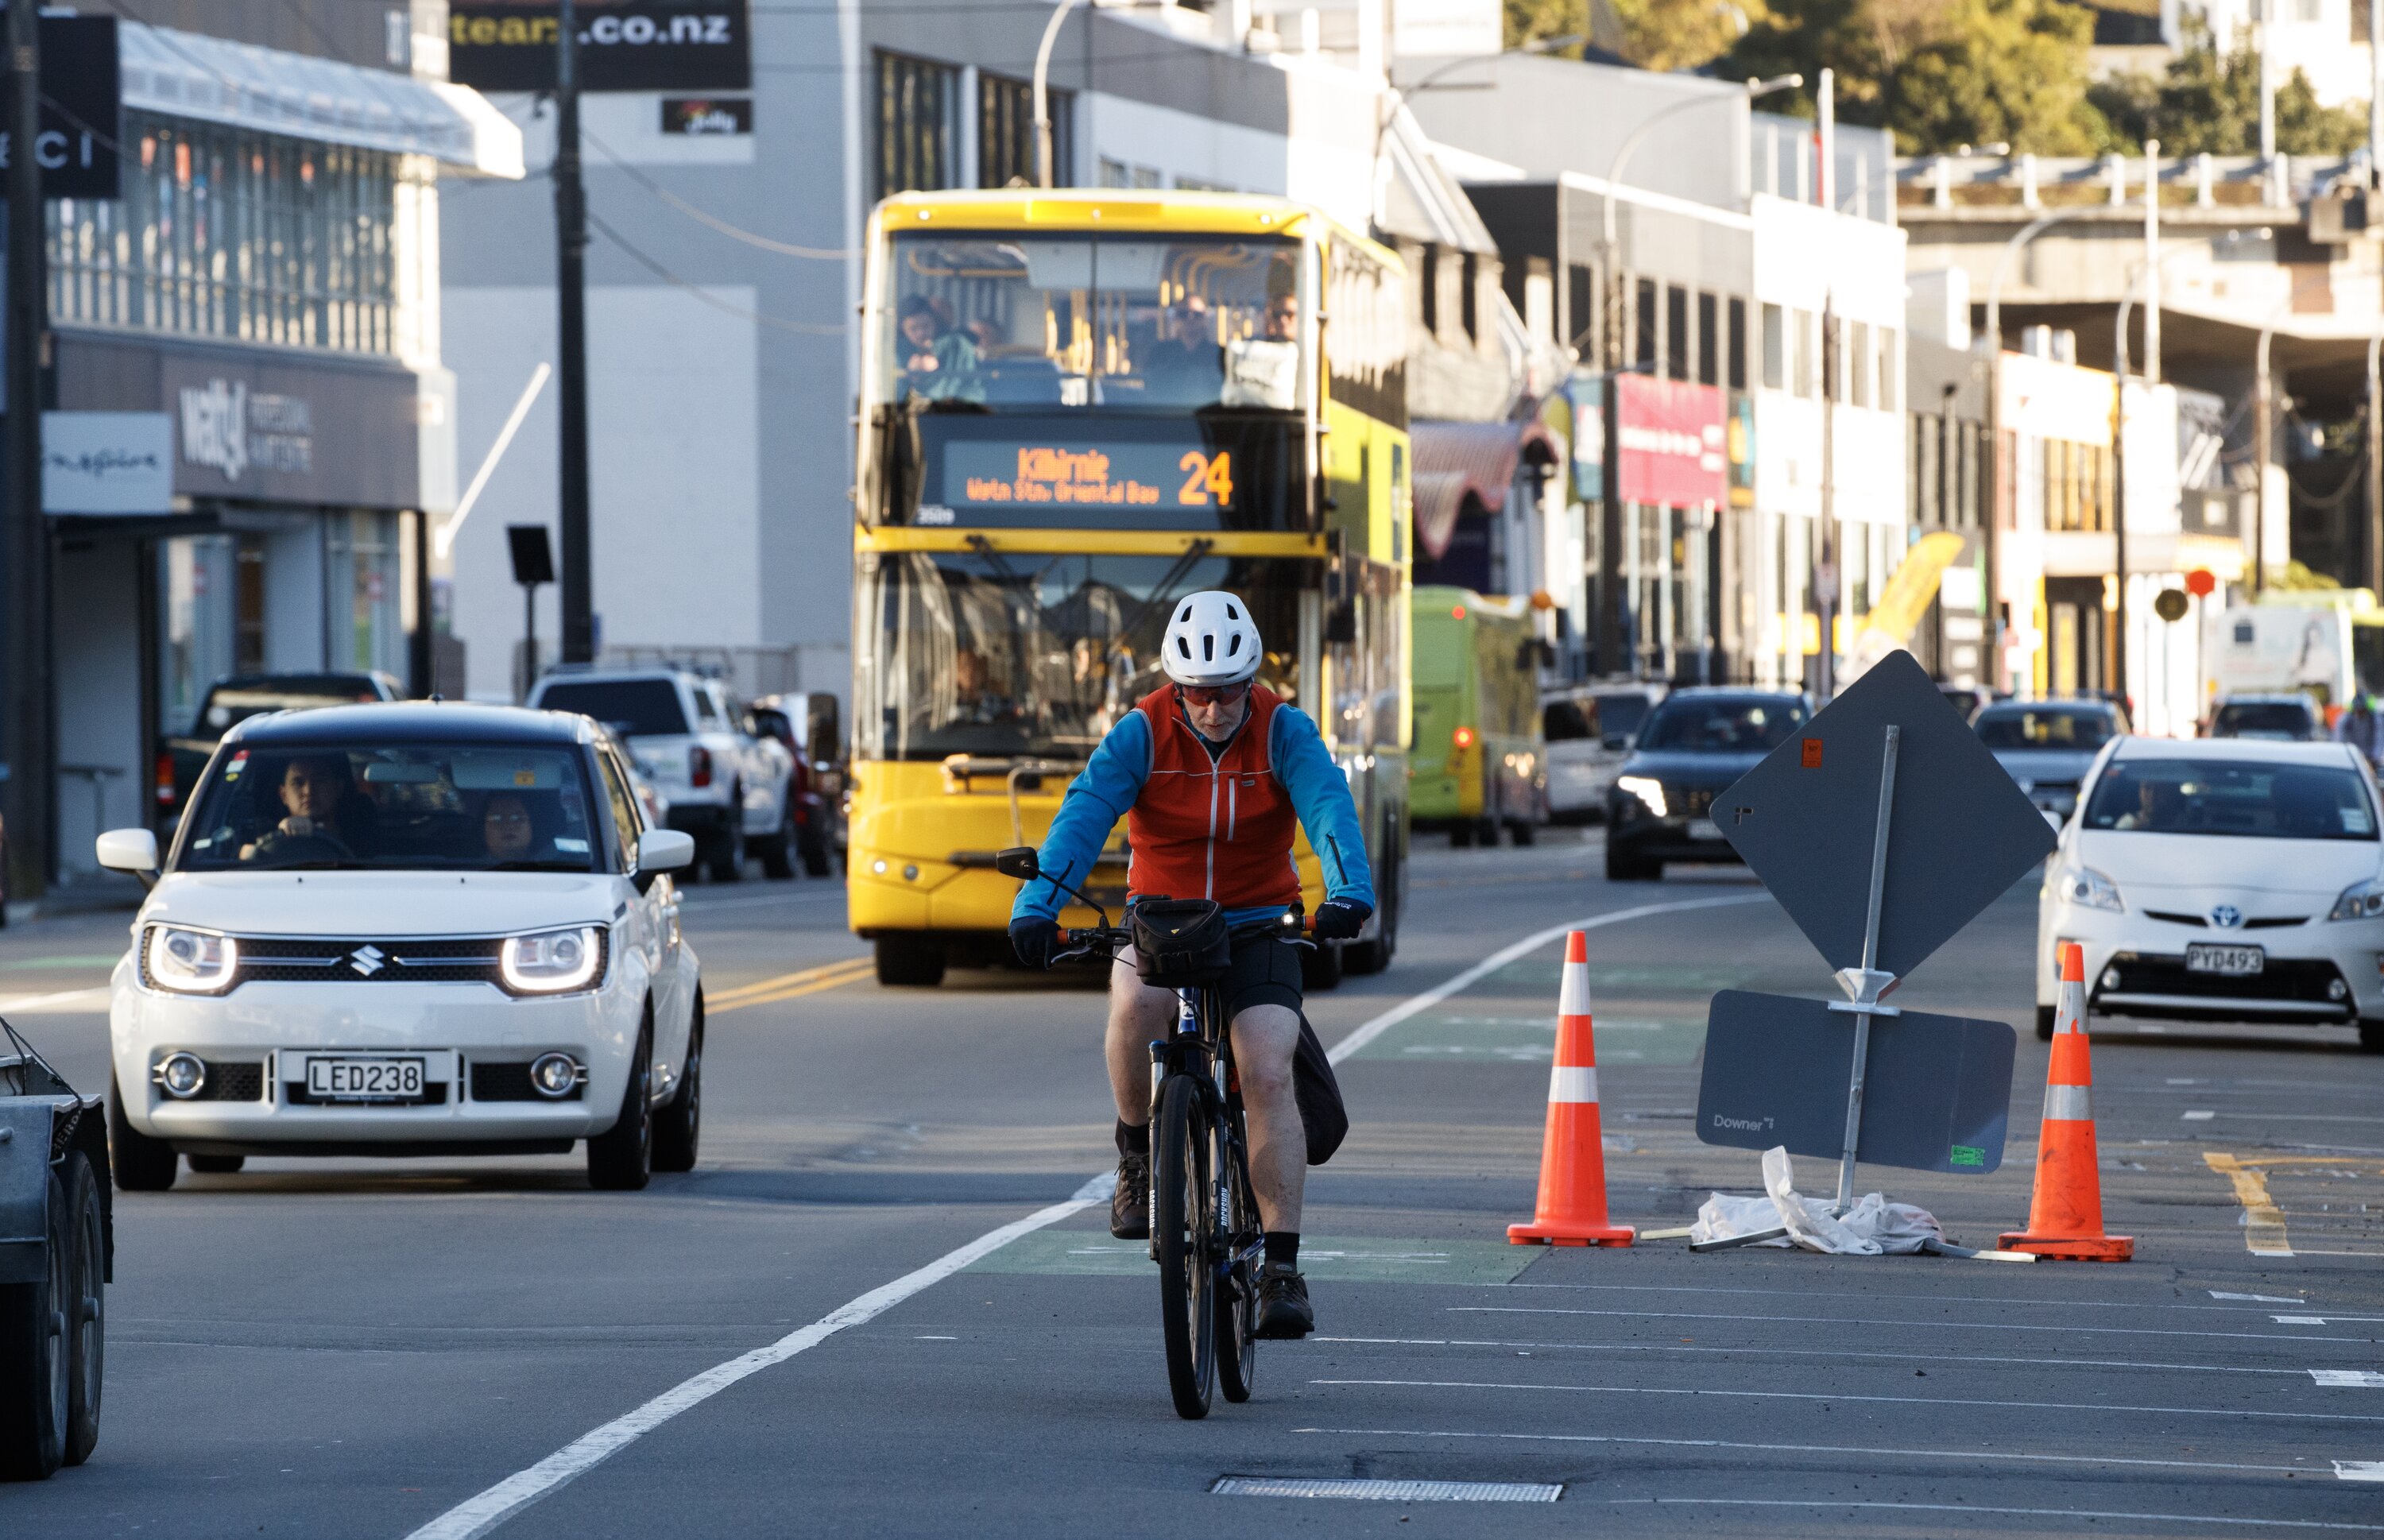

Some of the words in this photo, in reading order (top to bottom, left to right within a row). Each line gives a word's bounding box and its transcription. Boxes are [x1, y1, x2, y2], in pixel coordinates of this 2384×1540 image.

[1016, 447, 1110, 482] Kilbirnie
[1178, 451, 1233, 506] 24
[1126, 480, 1160, 505] Bay
[2189, 950, 2262, 972] PYD493
[312, 1066, 418, 1092] LED238
[1713, 1114, 1763, 1132] Downer
